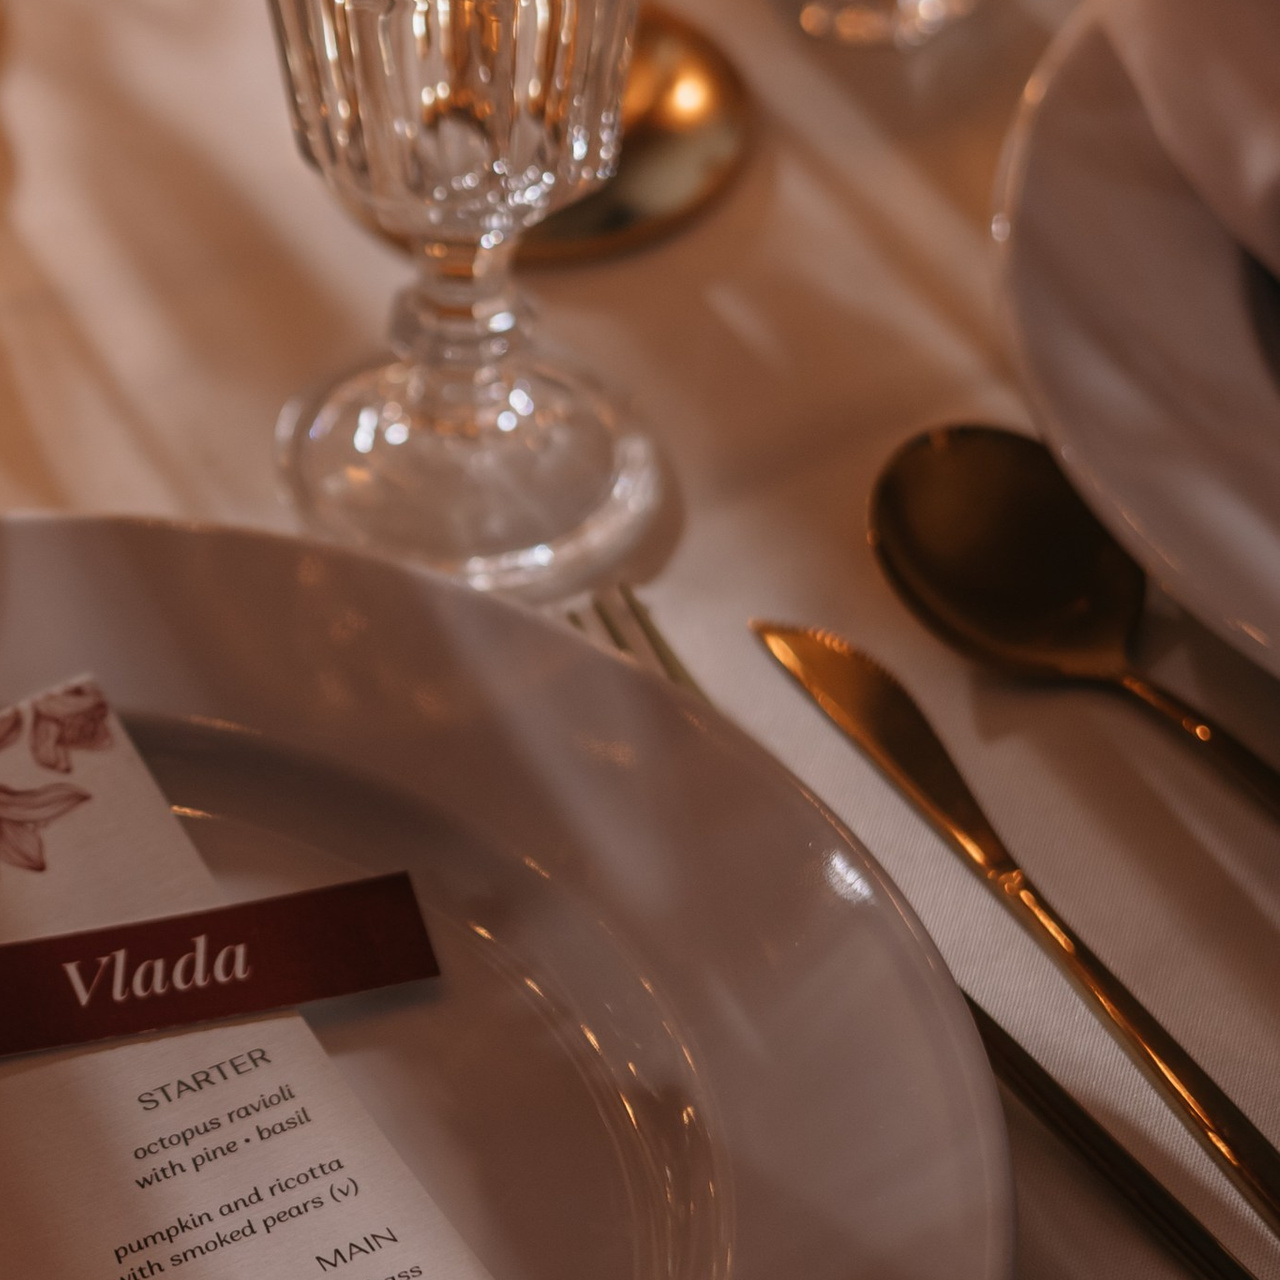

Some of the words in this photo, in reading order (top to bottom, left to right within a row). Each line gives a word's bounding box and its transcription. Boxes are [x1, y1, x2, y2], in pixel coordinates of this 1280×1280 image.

[61, 933, 253, 1007] Vlada
[136, 1047, 272, 1111] STARTER
[133, 1116, 221, 1160] octopus
[226, 1083, 296, 1123] ravioli
[134, 1160, 187, 1189] with
[191, 1140, 239, 1172] pine
[255, 1106, 312, 1141] basil
[113, 1210, 214, 1264] pumpkin
[218, 1186, 264, 1217] and
[268, 1157, 345, 1197] ricotta
[169, 1218, 257, 1267] smoked
[261, 1195, 325, 1234] pears
[329, 1177, 359, 1203] (v)
[314, 1226, 399, 1272] MAIN
